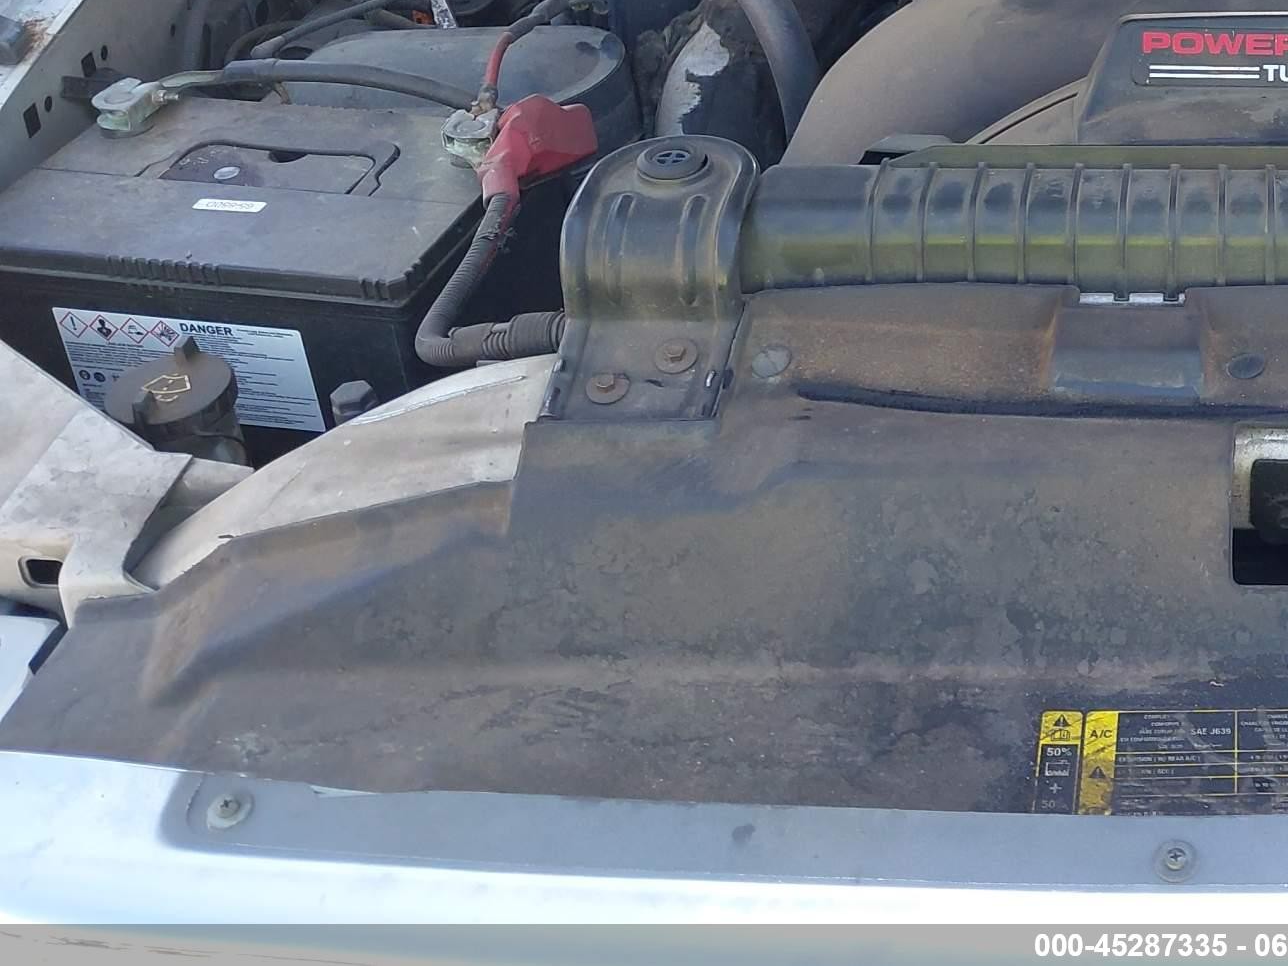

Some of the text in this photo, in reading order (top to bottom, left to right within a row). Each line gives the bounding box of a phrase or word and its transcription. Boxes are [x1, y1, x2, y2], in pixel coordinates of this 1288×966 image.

[179, 322, 233, 337] DANGER
[1089, 729, 1113, 739] A/C
[1190, 728, 1208, 736] SAE
[1210, 727, 1232, 735] J639
[1046, 747, 1073, 757] 50%
